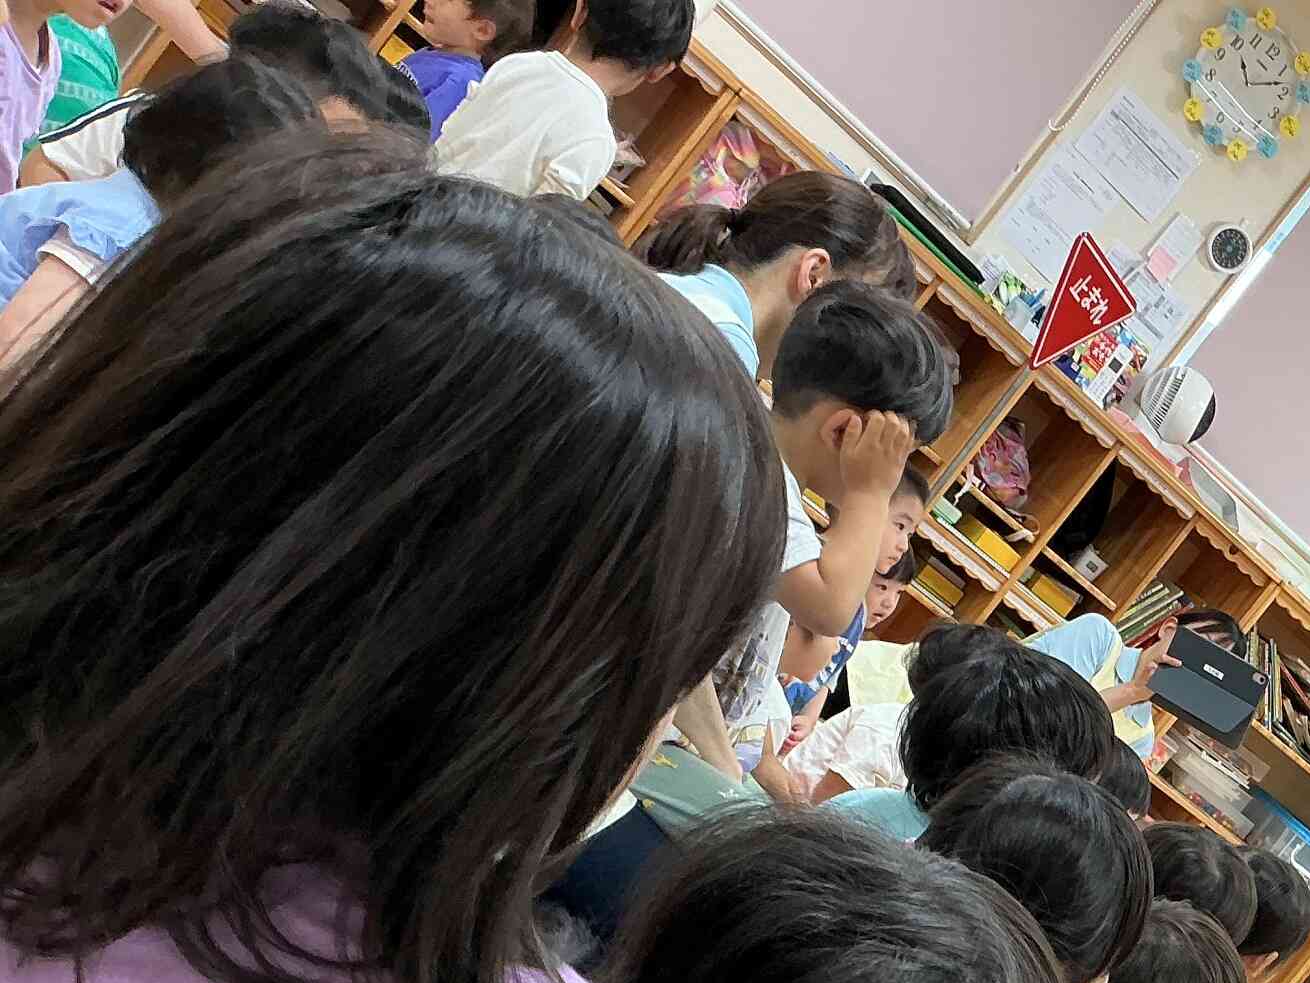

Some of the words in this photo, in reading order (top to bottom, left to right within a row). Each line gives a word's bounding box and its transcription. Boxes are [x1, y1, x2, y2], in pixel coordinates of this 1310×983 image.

[1230, 34, 1244, 51] 10
[1250, 33, 1262, 49] 11
[1214, 47, 1226, 61] 9
[1265, 42, 1281, 61] 12
[1205, 68, 1216, 81] 8
[1278, 64, 1288, 77] 1
[1277, 86, 1289, 100] 2
[1267, 106, 1280, 120] 3
[1069, 275, 1109, 325] 止まれ
